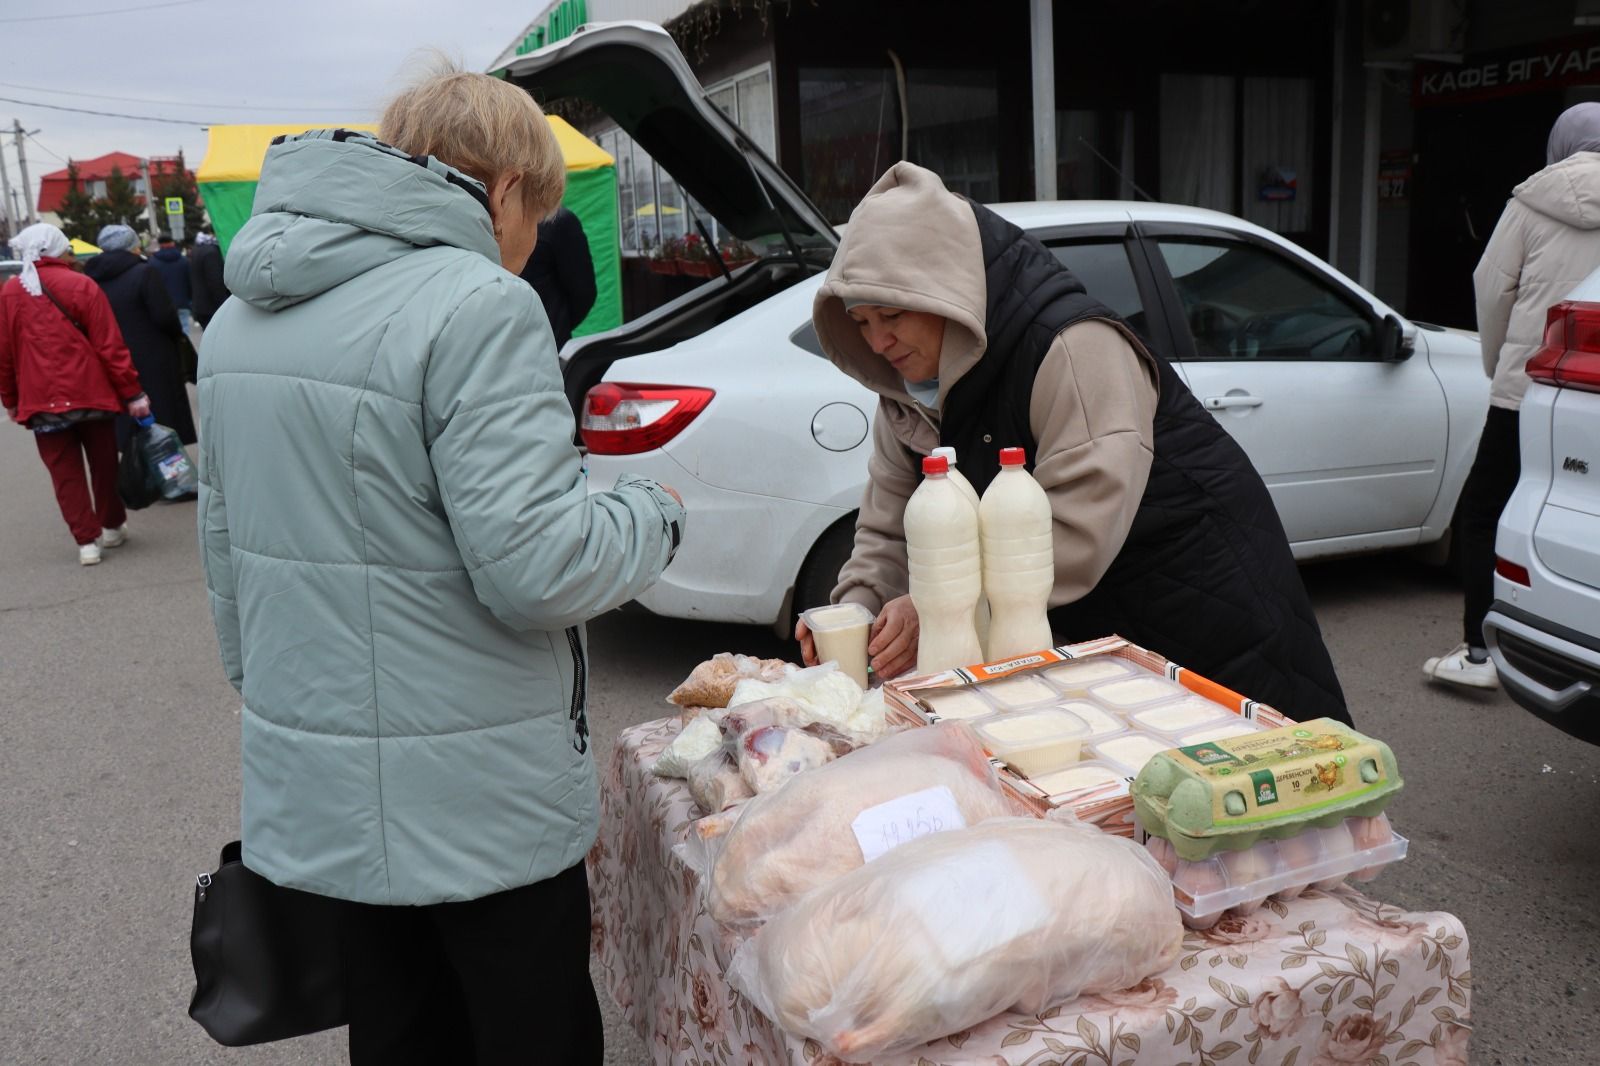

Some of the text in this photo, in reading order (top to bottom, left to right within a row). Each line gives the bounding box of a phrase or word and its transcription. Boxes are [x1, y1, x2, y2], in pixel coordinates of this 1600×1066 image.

[1421, 47, 1600, 96] КАФЕ ЯГУАР
[1276, 768, 1313, 783] ДЕРЕВЕНСКОЕ
[1292, 780, 1300, 789] 10
